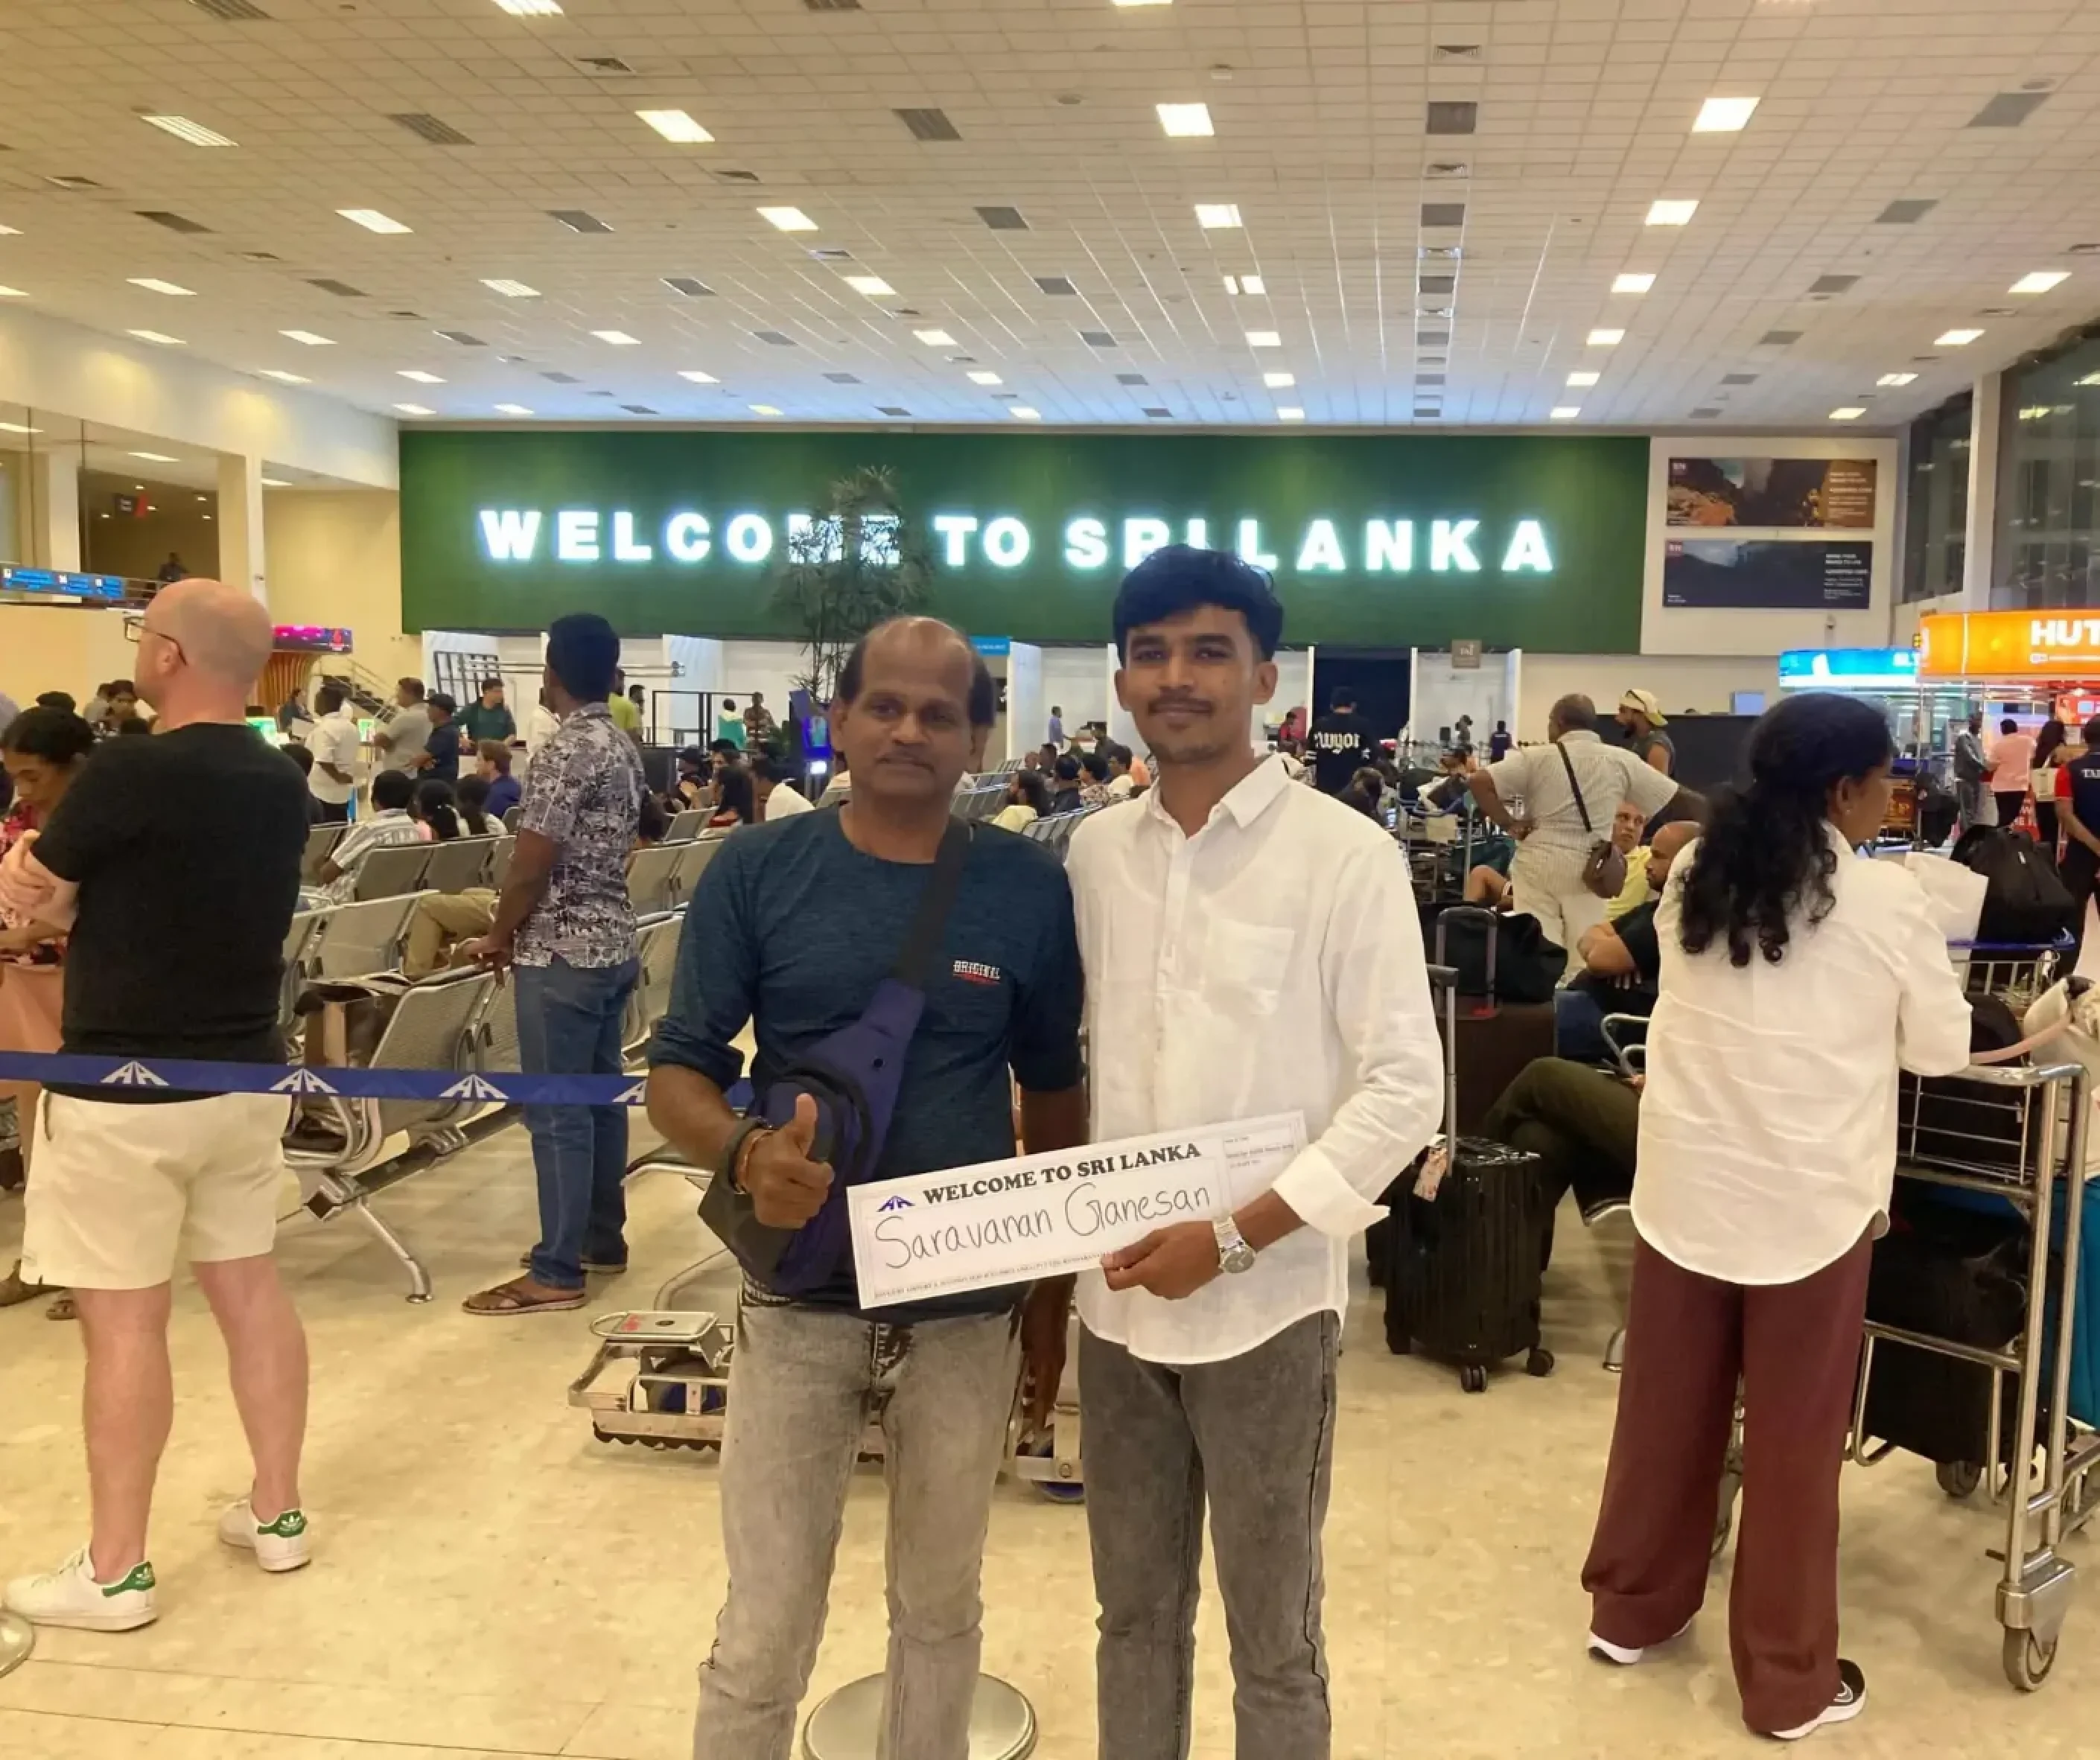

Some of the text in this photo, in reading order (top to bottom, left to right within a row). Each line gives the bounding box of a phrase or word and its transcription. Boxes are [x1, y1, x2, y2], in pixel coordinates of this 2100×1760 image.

[935, 515, 1030, 567] TO
[1240, 518, 1553, 571] LANKA
[922, 1170, 1037, 1205] WELCOME
[1040, 1165, 1072, 1183] TO
[1076, 1156, 1116, 1177] SRI
[1119, 1143, 1202, 1170] LANKA
[875, 1182, 1210, 1269] Saravanan Ganesan
